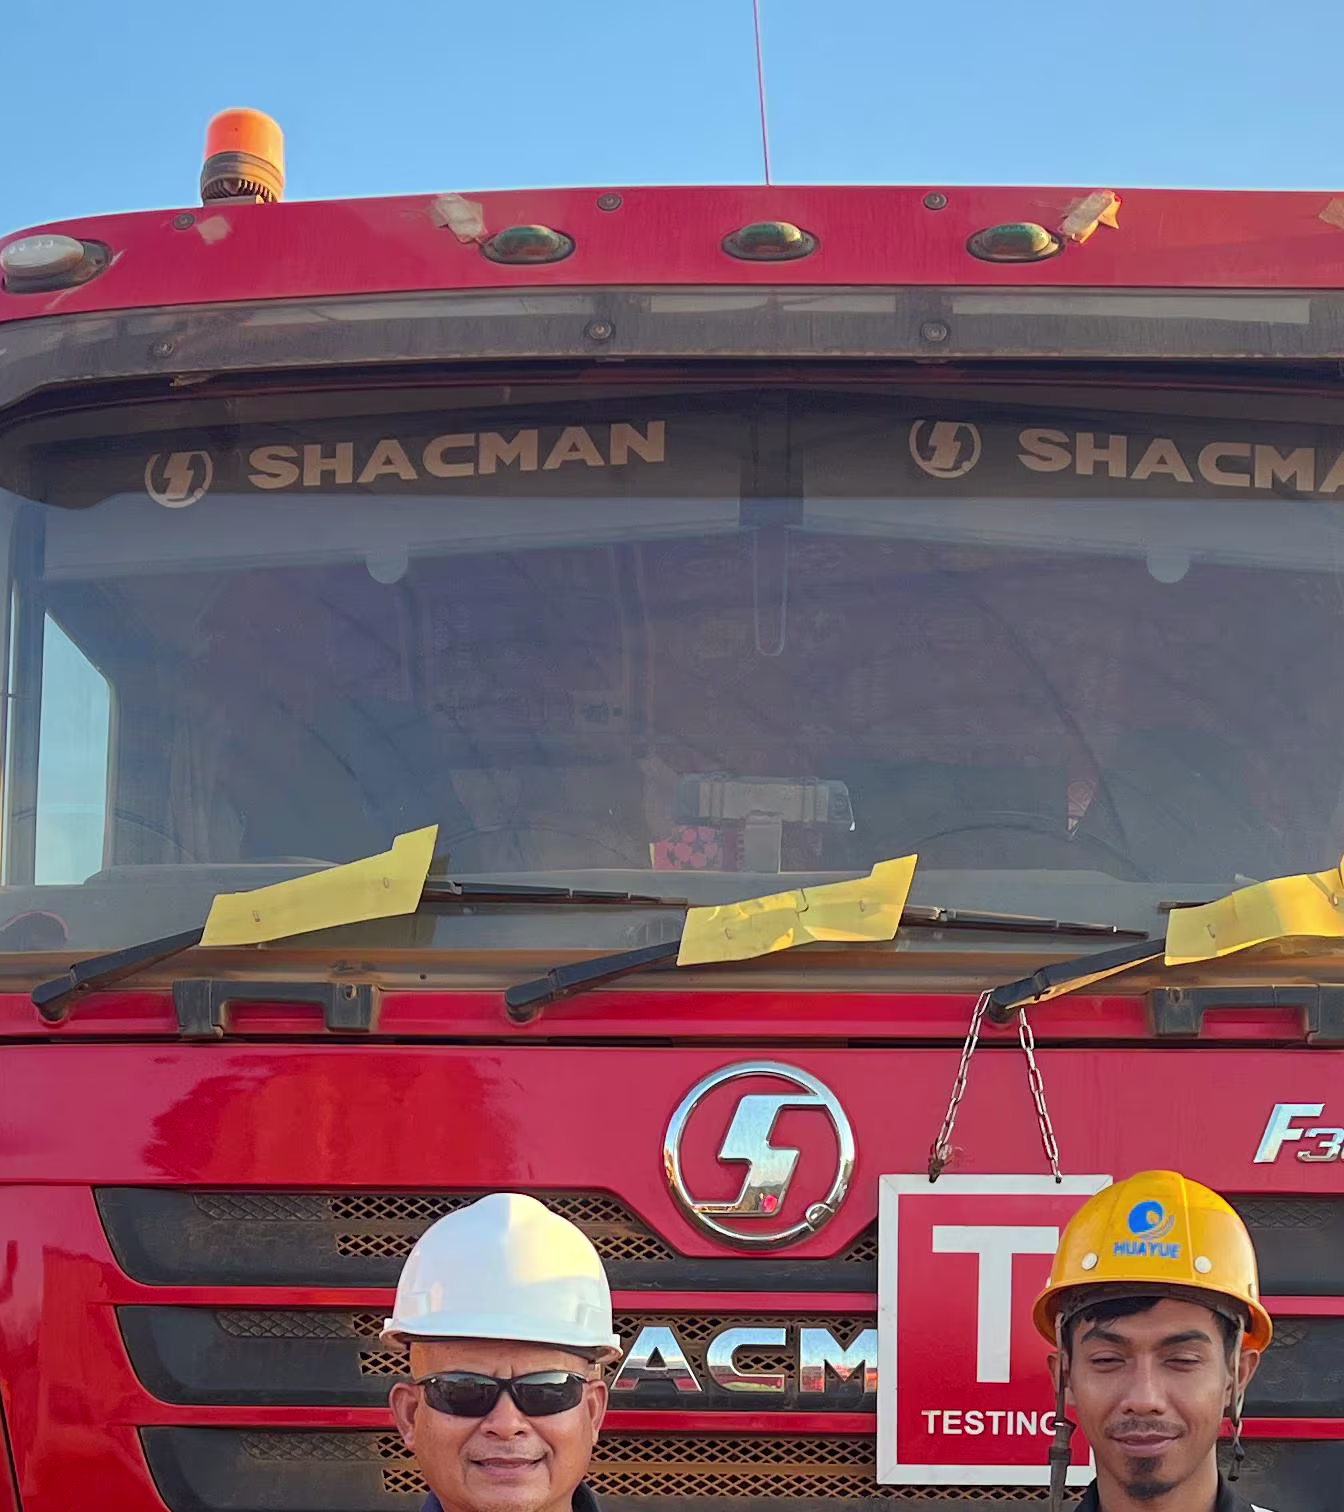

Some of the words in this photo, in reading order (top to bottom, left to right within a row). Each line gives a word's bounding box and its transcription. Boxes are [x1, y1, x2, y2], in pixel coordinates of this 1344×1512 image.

[248, 420, 665, 490] SHACMAN
[1113, 1241, 1180, 1259] HUAYUE
[932, 1225, 1059, 1383] T
[610, 1326, 878, 1393] ACM
